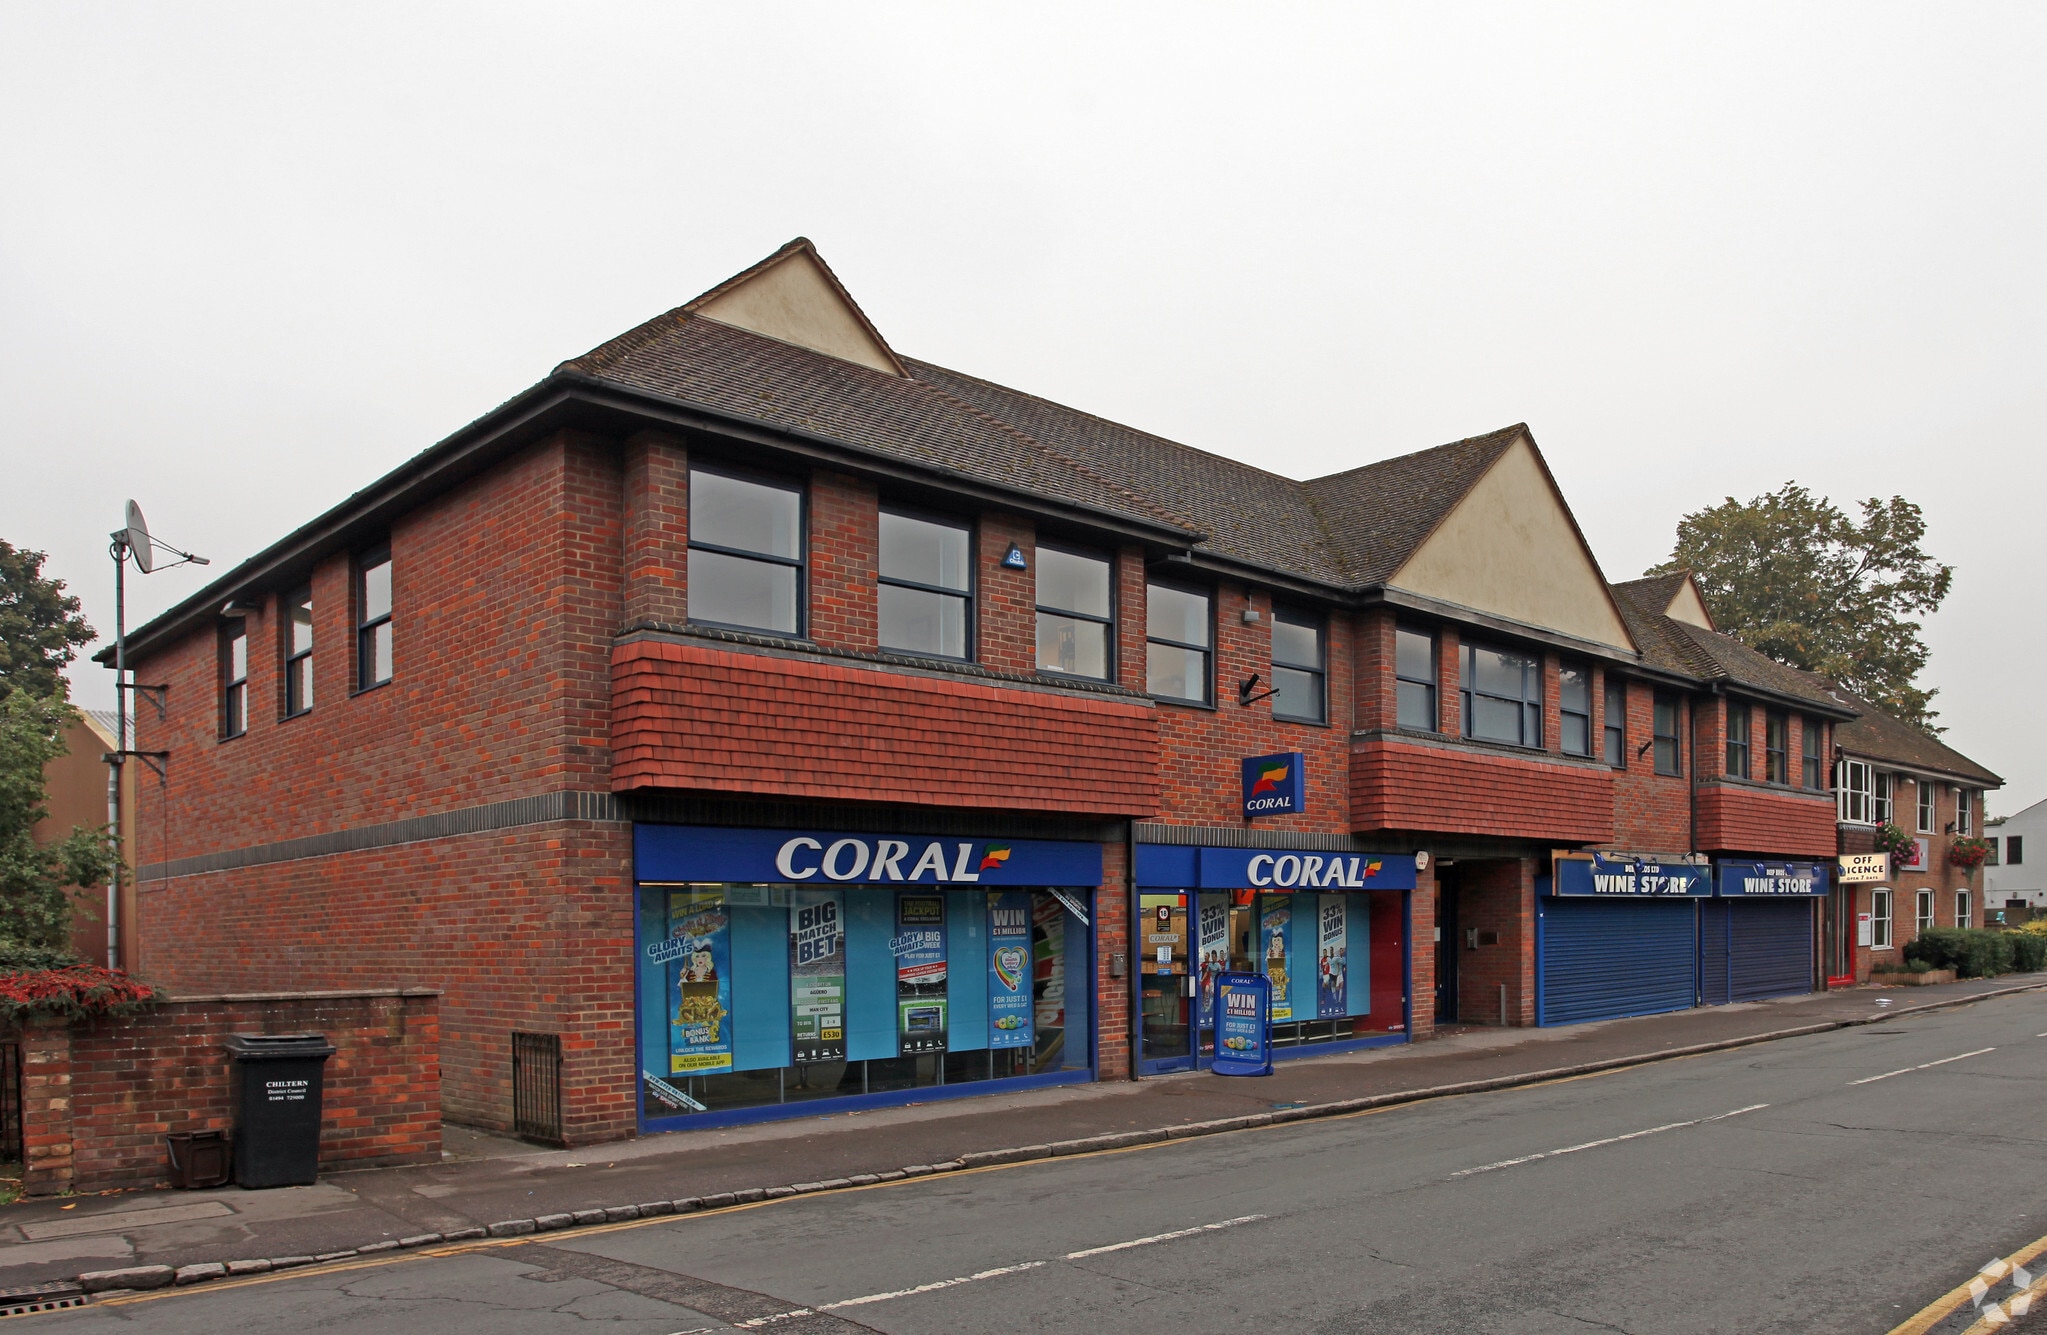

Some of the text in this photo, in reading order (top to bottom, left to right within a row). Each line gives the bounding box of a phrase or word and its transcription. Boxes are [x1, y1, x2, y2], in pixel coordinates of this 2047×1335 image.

[1247, 796, 1290, 810] CORAL
[775, 837, 979, 882] CORAL
[1247, 854, 1364, 888] CORAL
[1651, 865, 1660, 873] LTD
[1848, 866, 1884, 874] ICENCE
[1594, 874, 1636, 892] WINE
[1744, 878, 1812, 892] WINE STORE
[799, 901, 836, 930] BIG
[904, 906, 940, 916] JACKPOT
[992, 909, 1025, 926] WIN
[1201, 902, 1224, 922] 33%
[1323, 904, 1342, 920] 33%
[799, 922, 836, 942] MATCH
[993, 927, 1026, 936] £1 MILLION
[1202, 916, 1224, 936] WIN
[1323, 916, 1342, 932] WIN
[890, 932, 919, 948] GLORY
[926, 931, 940, 942] BIG
[1202, 930, 1224, 946] BONUS
[1324, 927, 1342, 941] BONUS
[648, 936, 686, 955] GLORY
[654, 944, 693, 962] AWAITS
[799, 933, 836, 964] BET
[894, 940, 924, 954] AWAITS
[1228, 994, 1256, 1008] WIN
[686, 1026, 710, 1038] BONUS
[690, 1036, 710, 1044] BANK
[823, 1030, 840, 1038] £530
